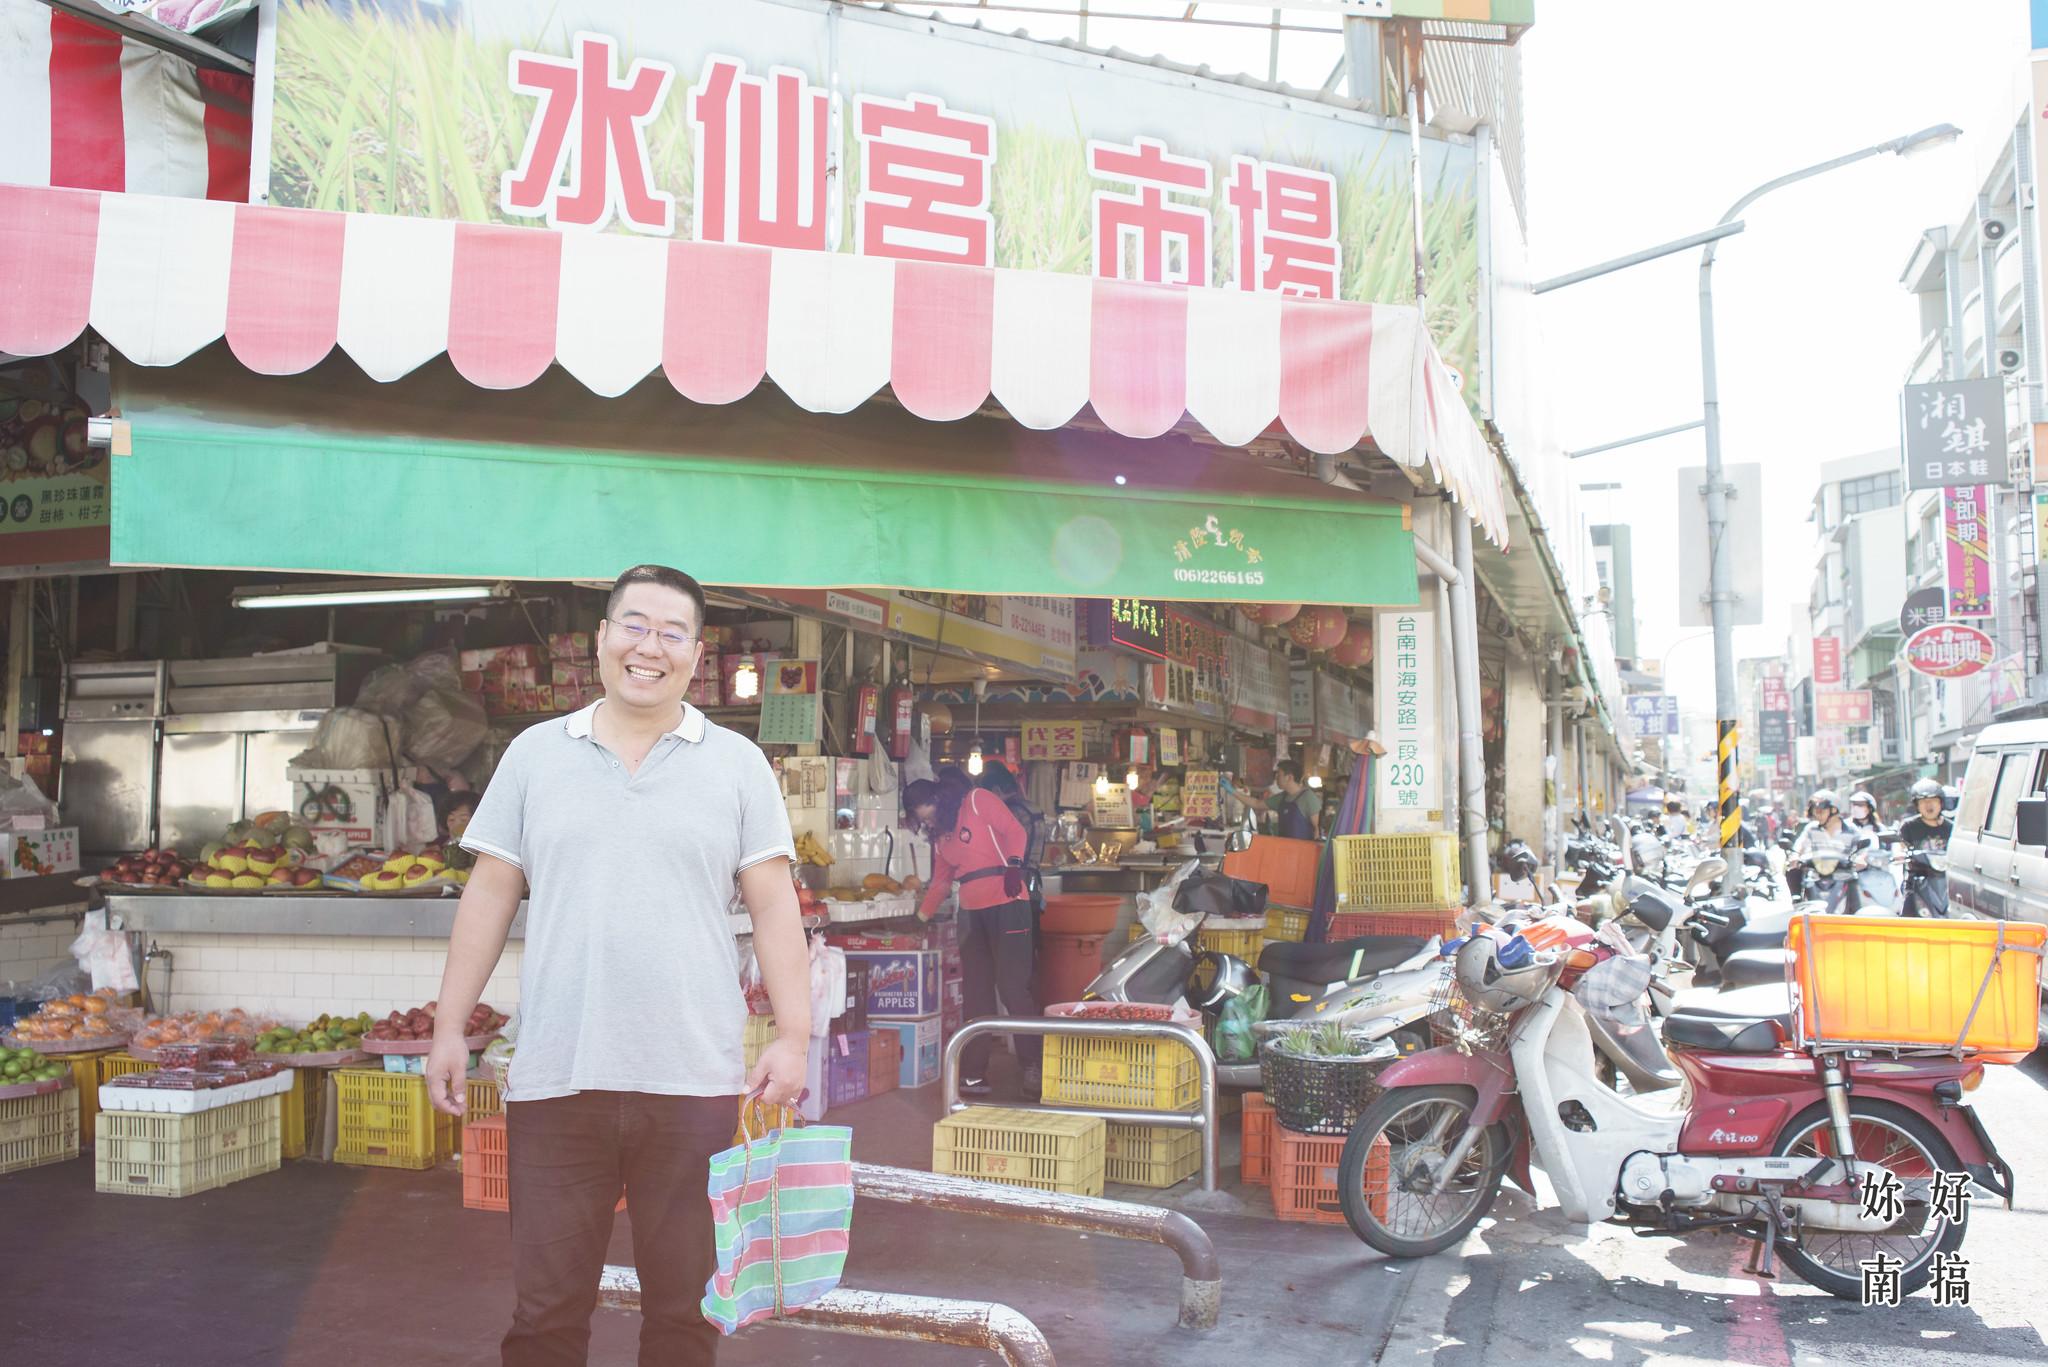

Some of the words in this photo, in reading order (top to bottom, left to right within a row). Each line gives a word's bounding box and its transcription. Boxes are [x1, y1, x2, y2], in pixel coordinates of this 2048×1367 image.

[504, 35, 994, 267] 水仙宮
[1090, 140, 1342, 300] 市場
[1926, 458, 1989, 480] 日本鞋
[1173, 568, 1265, 585] (06)2266165
[1027, 727, 1077, 741] 代客
[1027, 744, 1077, 758] 真空
[1077, 763, 1089, 778] 21
[878, 998, 916, 1008] APPLES
